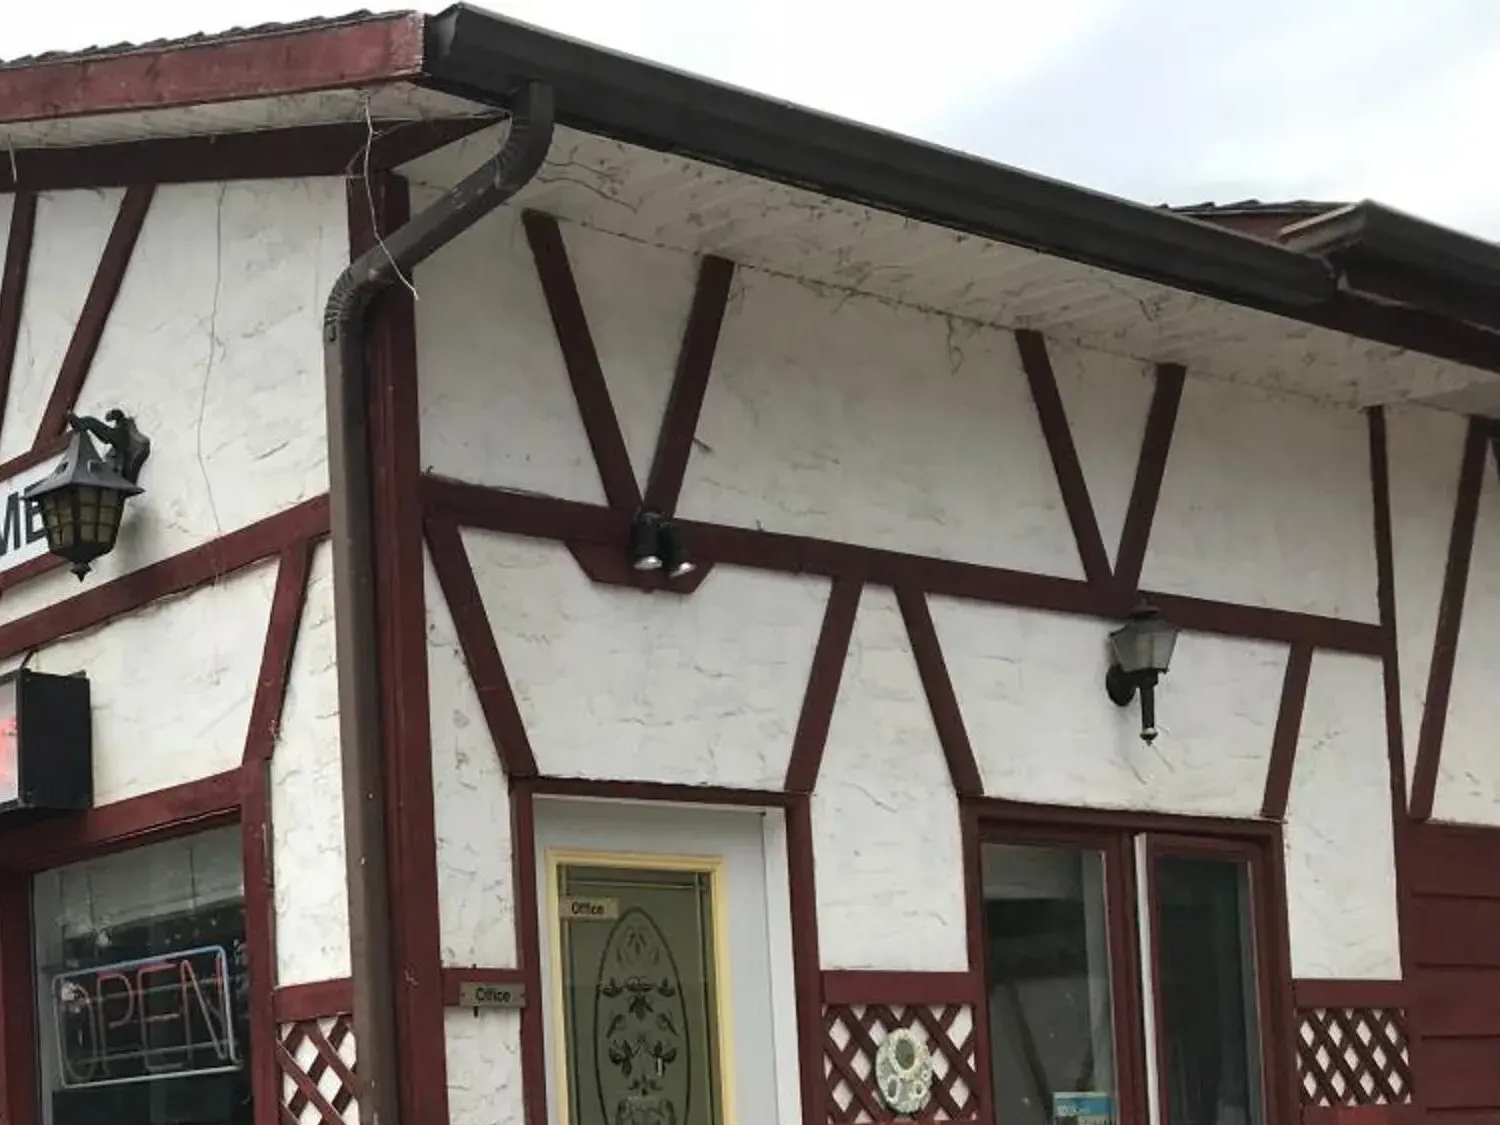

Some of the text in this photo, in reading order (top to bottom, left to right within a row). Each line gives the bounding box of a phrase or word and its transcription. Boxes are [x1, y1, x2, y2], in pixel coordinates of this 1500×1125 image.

[571, 901, 605, 915] Office
[475, 987, 511, 1002] Office
[62, 953, 228, 1082] OPEN
